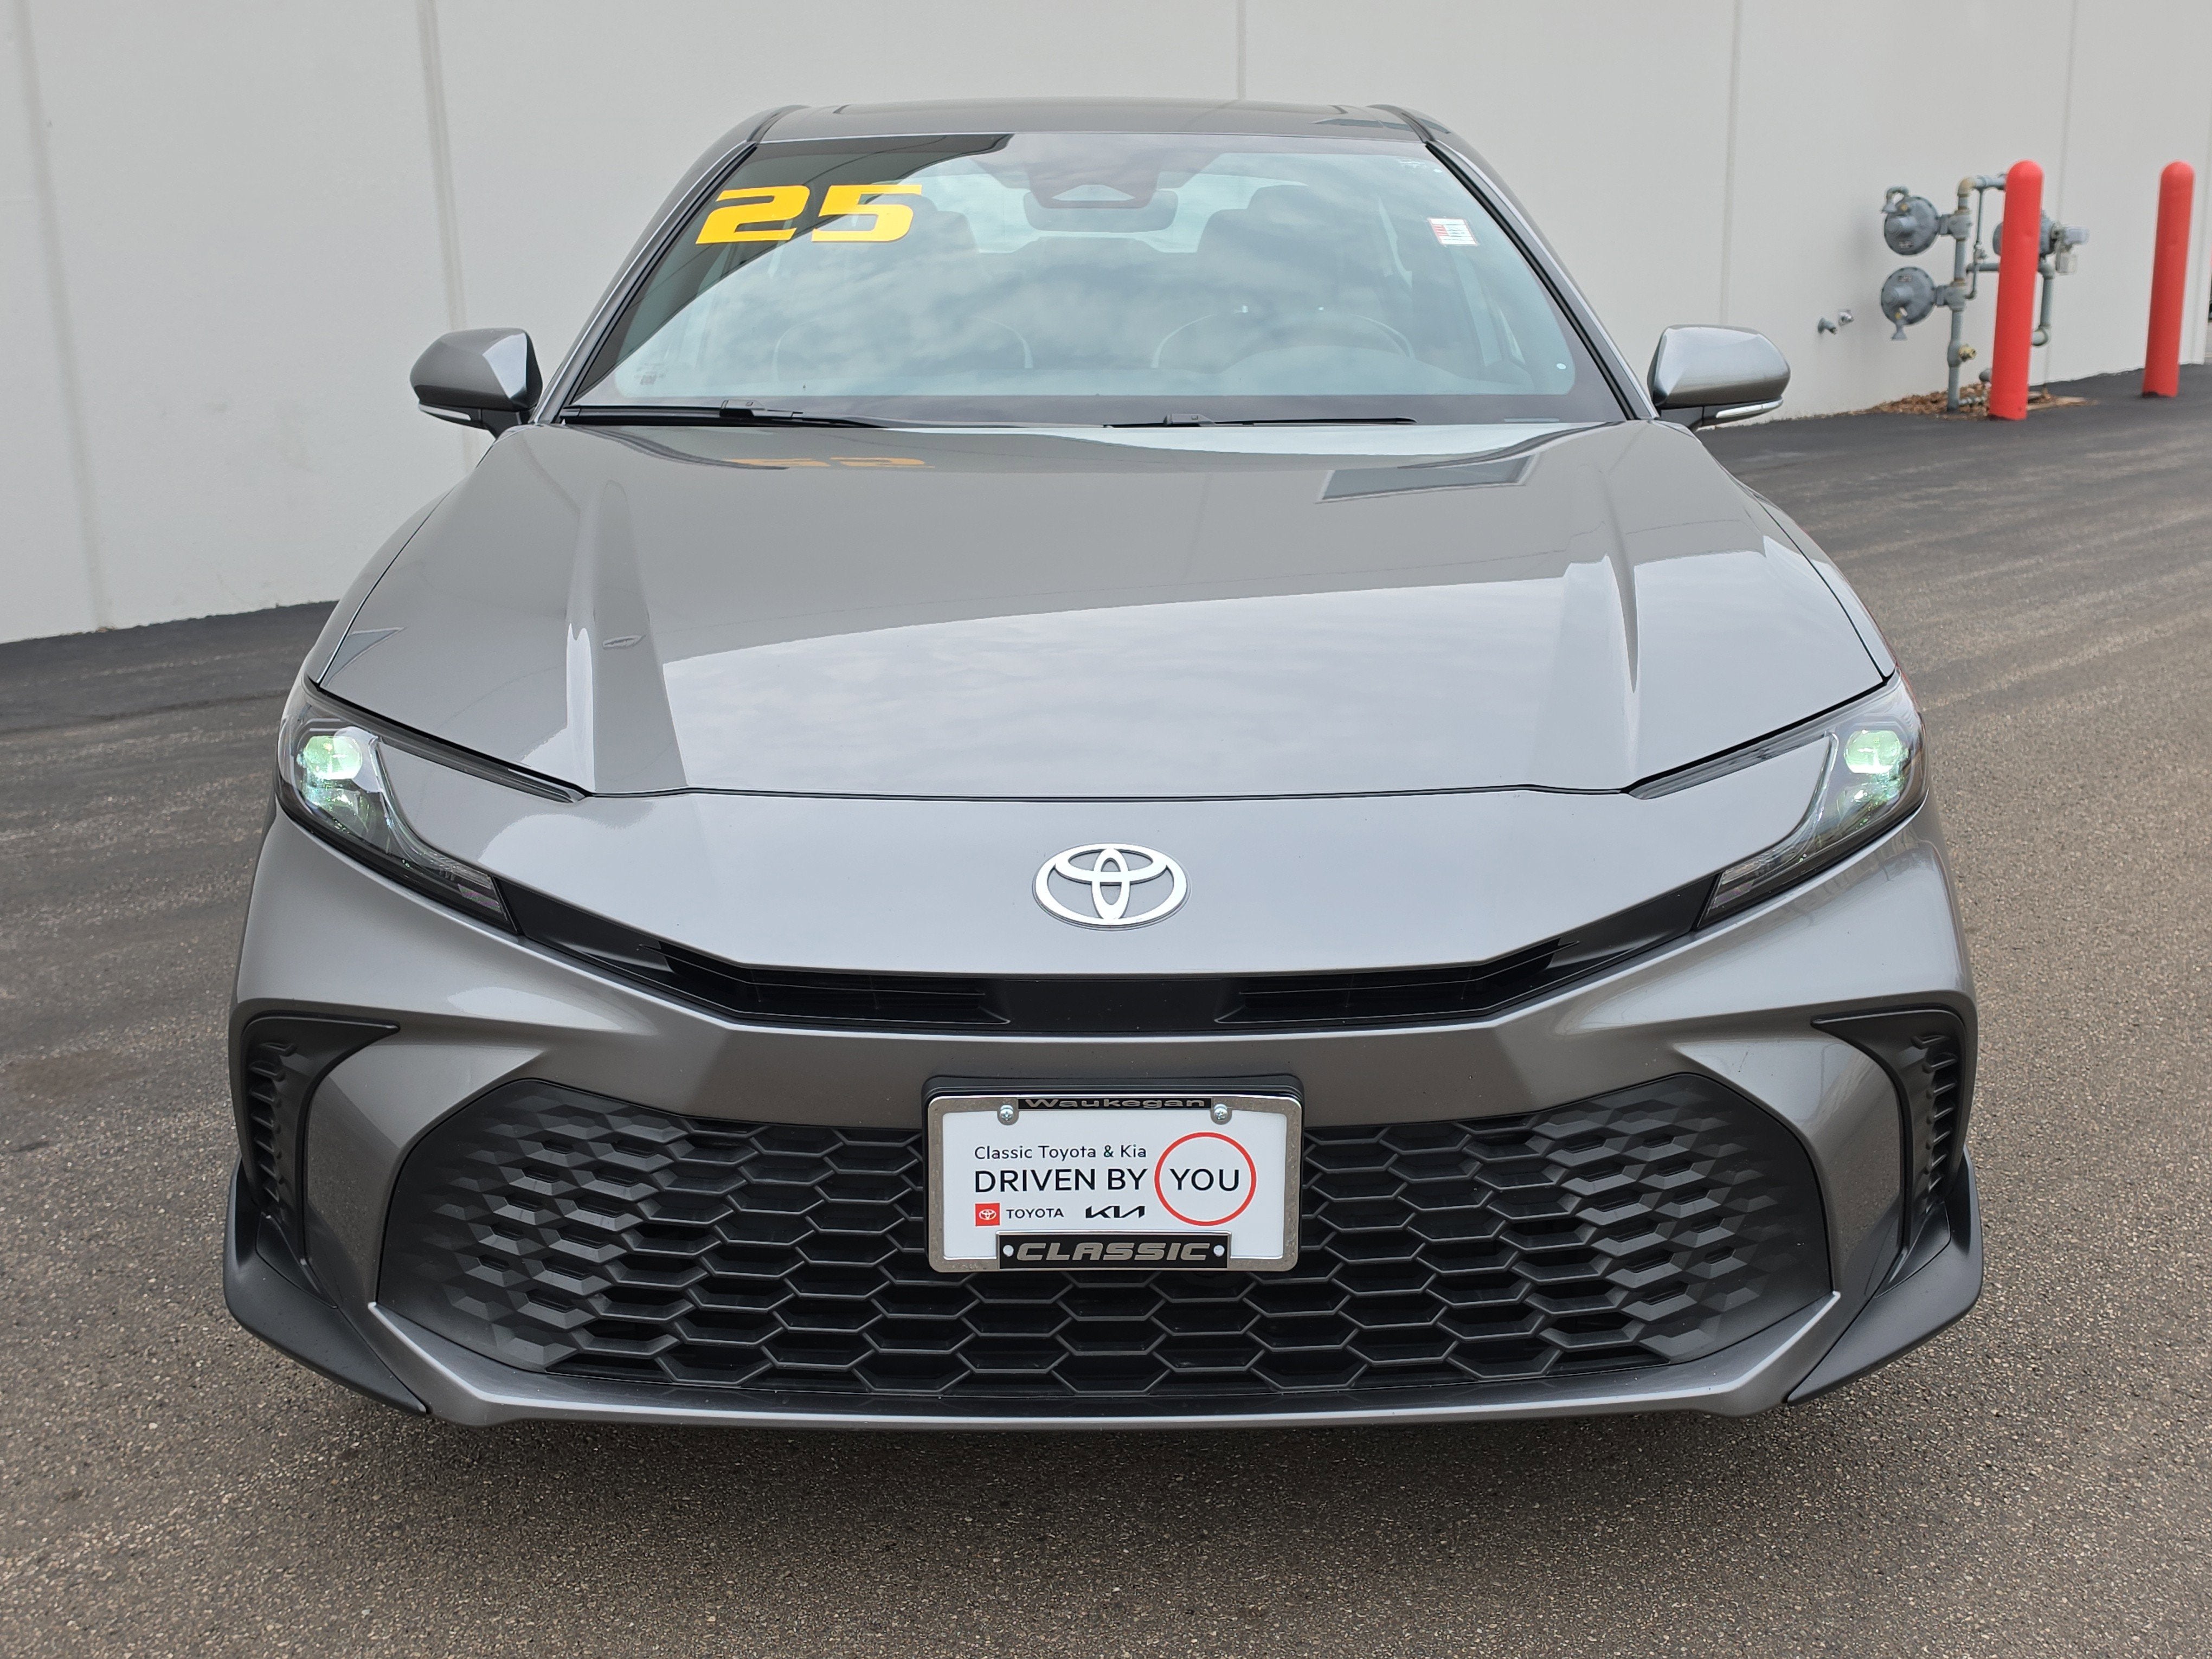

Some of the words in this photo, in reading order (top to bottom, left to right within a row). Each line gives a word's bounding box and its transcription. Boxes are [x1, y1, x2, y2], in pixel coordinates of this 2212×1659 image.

[696, 184, 922, 245] 25
[1025, 1098, 1205, 1108] Waukegan
[974, 1145, 1033, 1160] Classic
[1038, 1145, 1096, 1161] Toyota
[1103, 1144, 1114, 1158] &
[1120, 1144, 1147, 1158] Kia
[975, 1168, 1096, 1193] DRIVEN
[1108, 1168, 1148, 1191] BY
[1169, 1168, 1240, 1192] YOU
[1006, 1208, 1065, 1219] TOYOTA
[1016, 1242, 1210, 1261] CLASSIC
